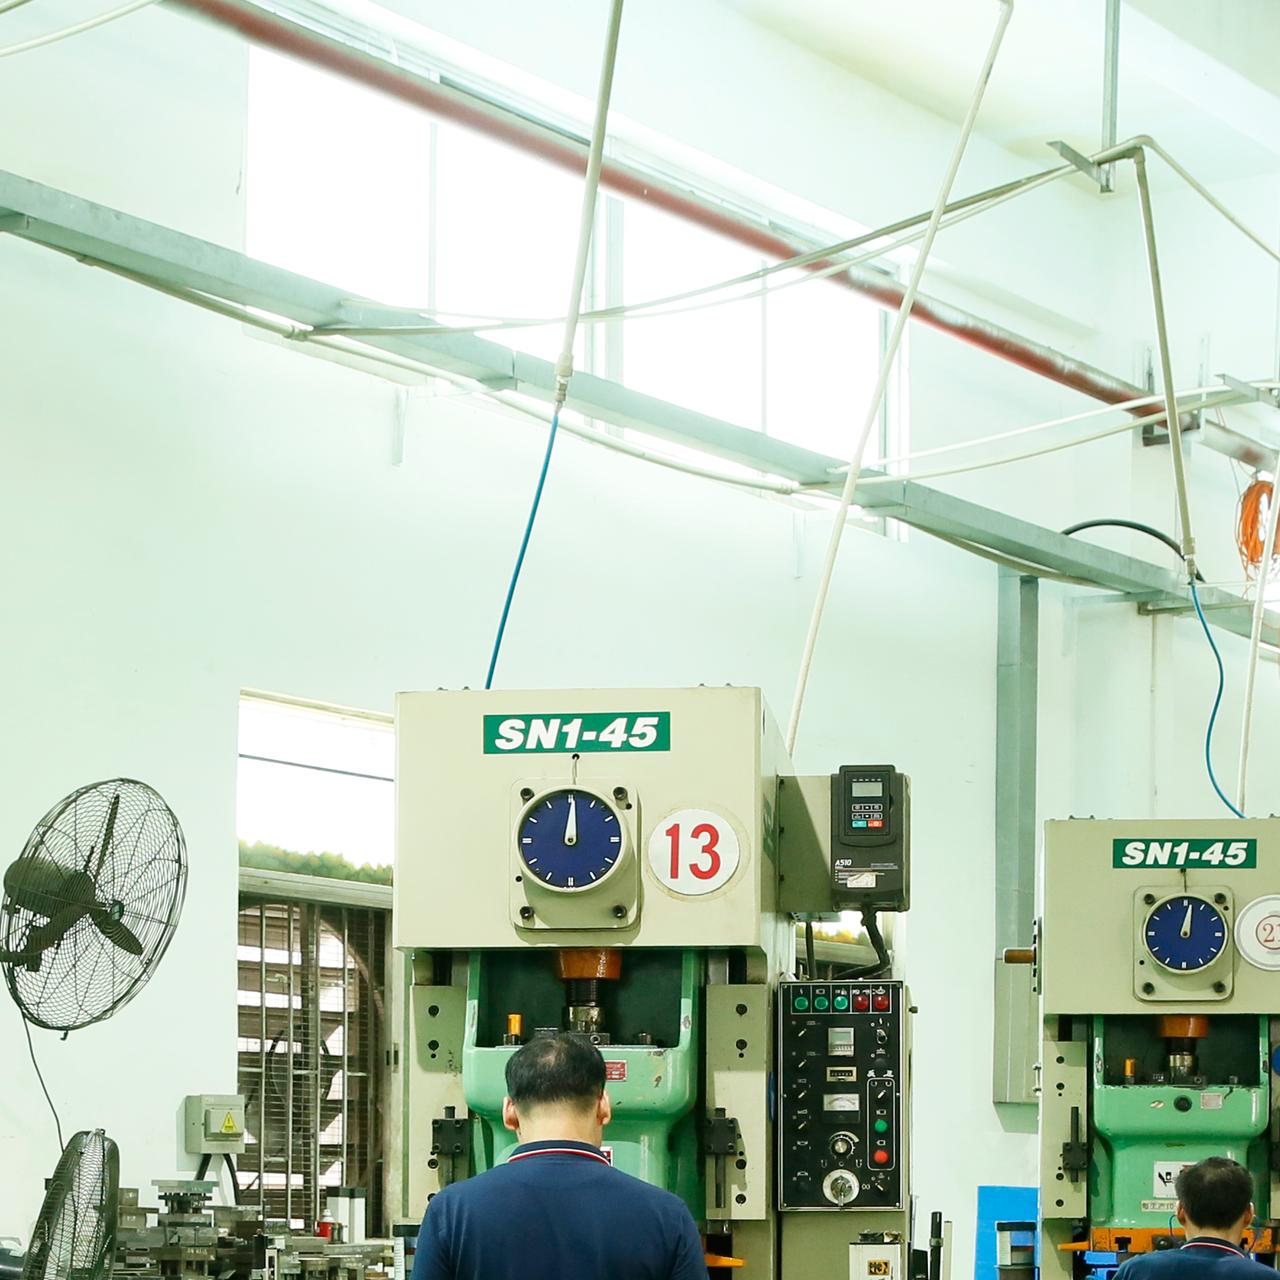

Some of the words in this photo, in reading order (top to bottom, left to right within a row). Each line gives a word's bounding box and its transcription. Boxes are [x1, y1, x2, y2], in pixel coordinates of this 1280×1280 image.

[494, 716, 659, 751] SN1-45
[663, 822, 722, 880] 13
[1121, 841, 1249, 866] SN1-45
